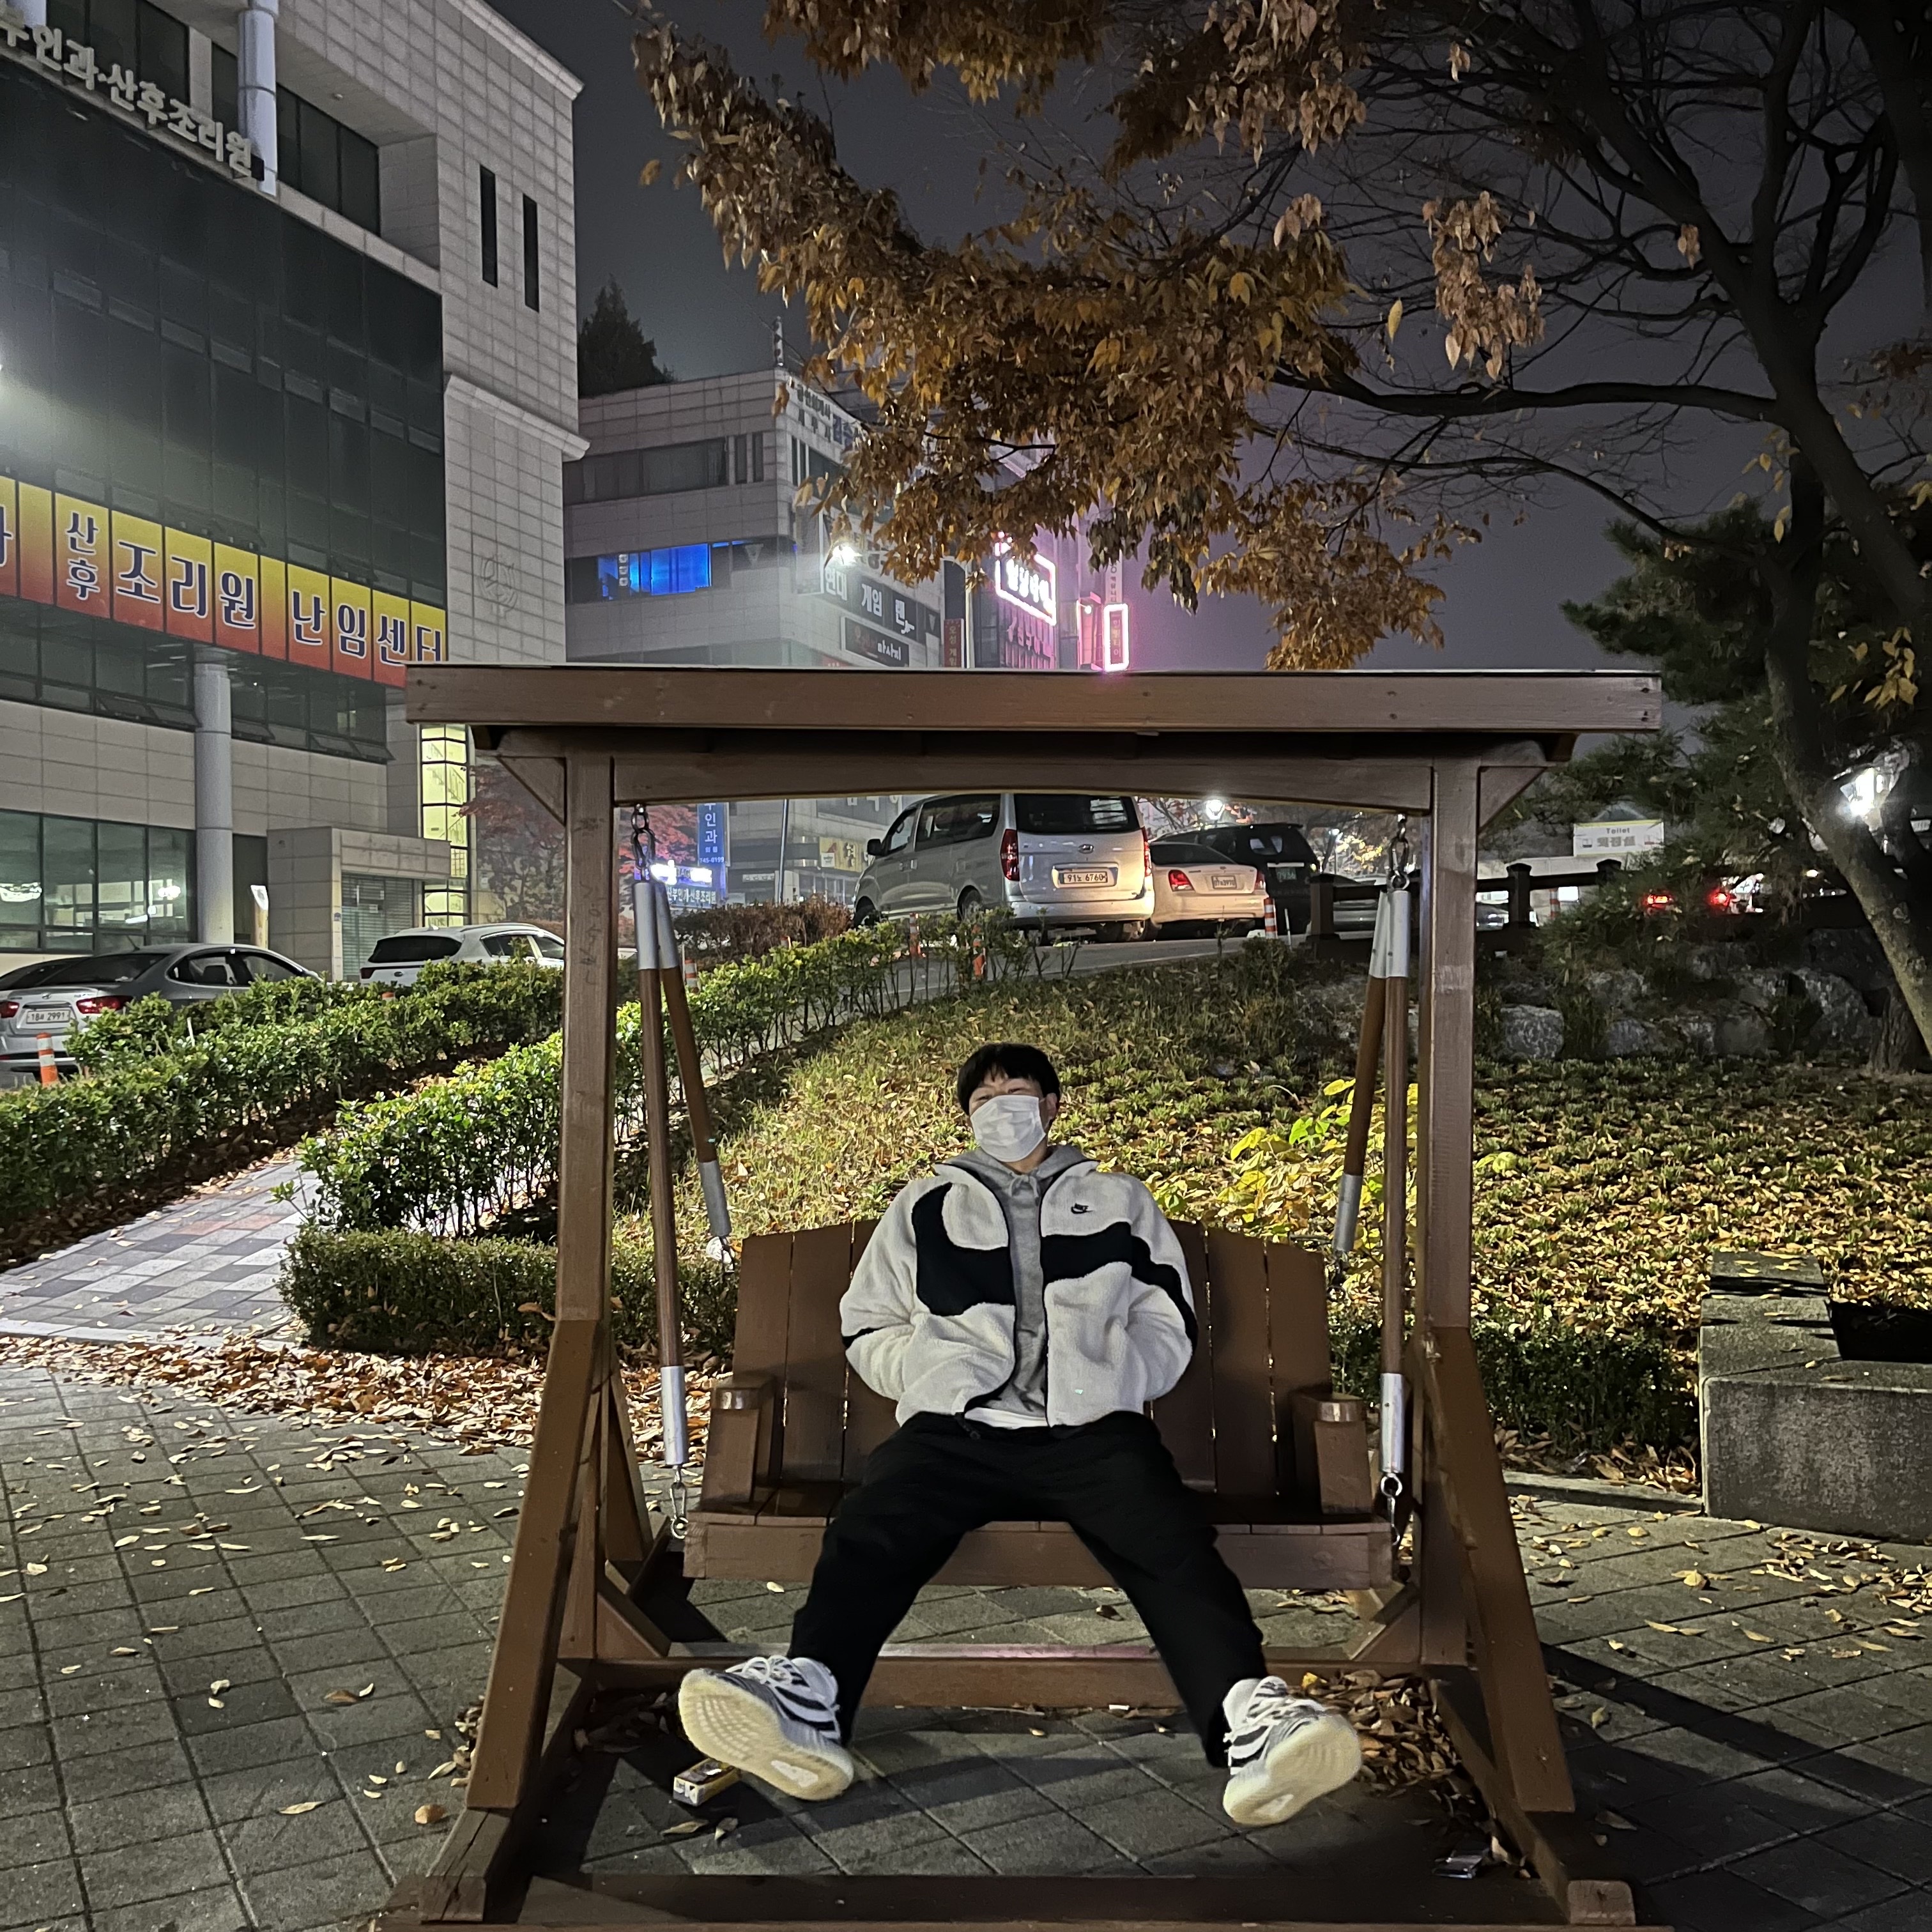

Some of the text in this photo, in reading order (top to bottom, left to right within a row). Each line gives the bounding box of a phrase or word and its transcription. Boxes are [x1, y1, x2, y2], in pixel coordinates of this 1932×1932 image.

[66, 510, 257, 629] 산후조리원
[290, 588, 442, 666] 난임센터
[861, 583, 883, 617] 게임
[1085, 873, 1103, 882] 6760
